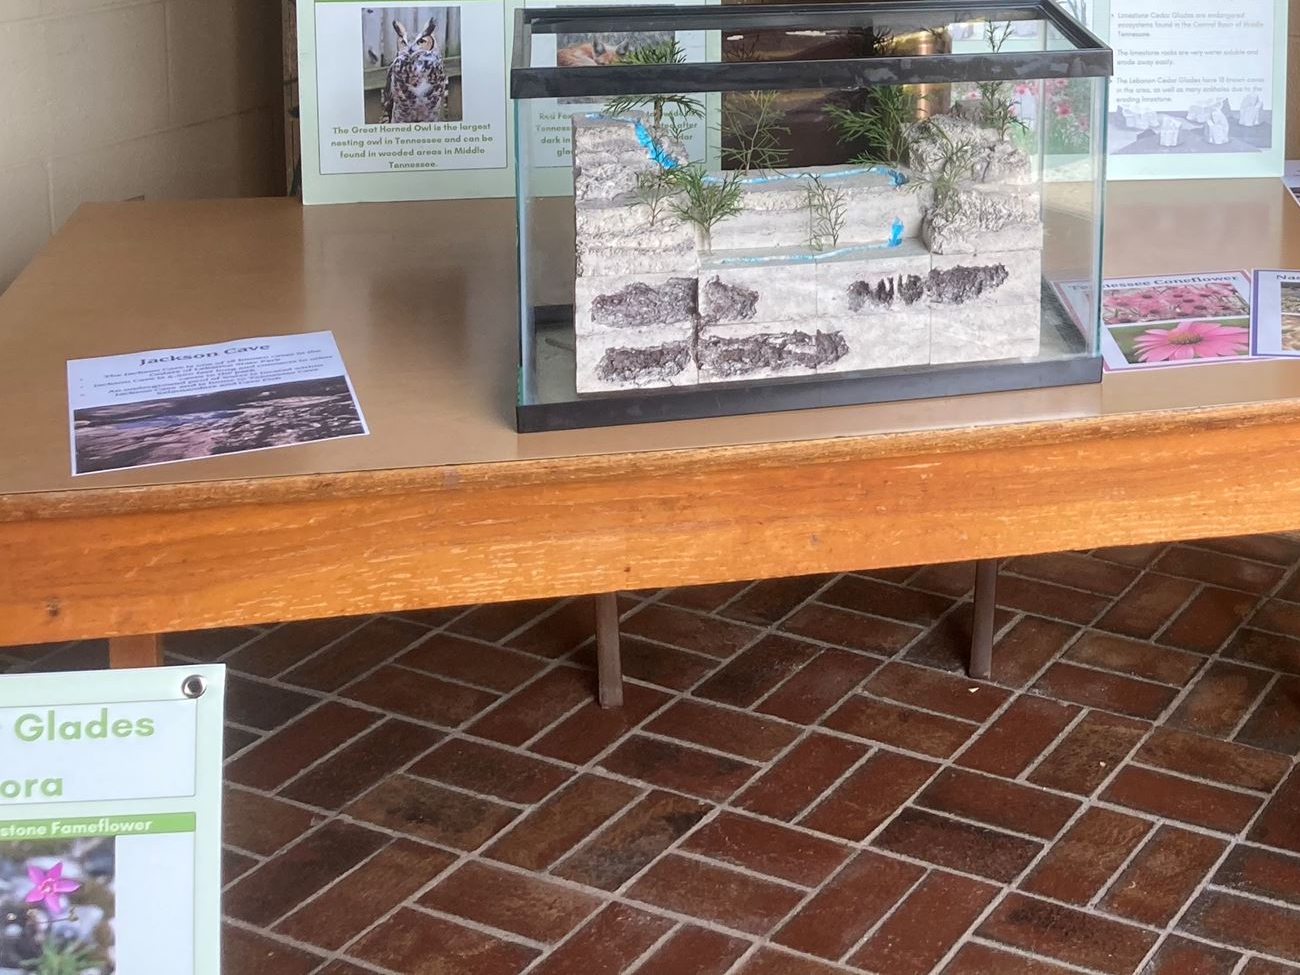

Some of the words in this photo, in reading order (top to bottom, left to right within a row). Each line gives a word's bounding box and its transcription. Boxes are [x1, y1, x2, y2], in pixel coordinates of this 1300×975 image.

[331, 138, 364, 147] nesting
[1154, 275, 1239, 285] Coneflower
[139, 350, 219, 366] Jackson
[224, 344, 270, 355] Cave
[0, 776, 63, 798] ora
[0, 824, 47, 838] stone
[51, 818, 152, 835] Fameflower
